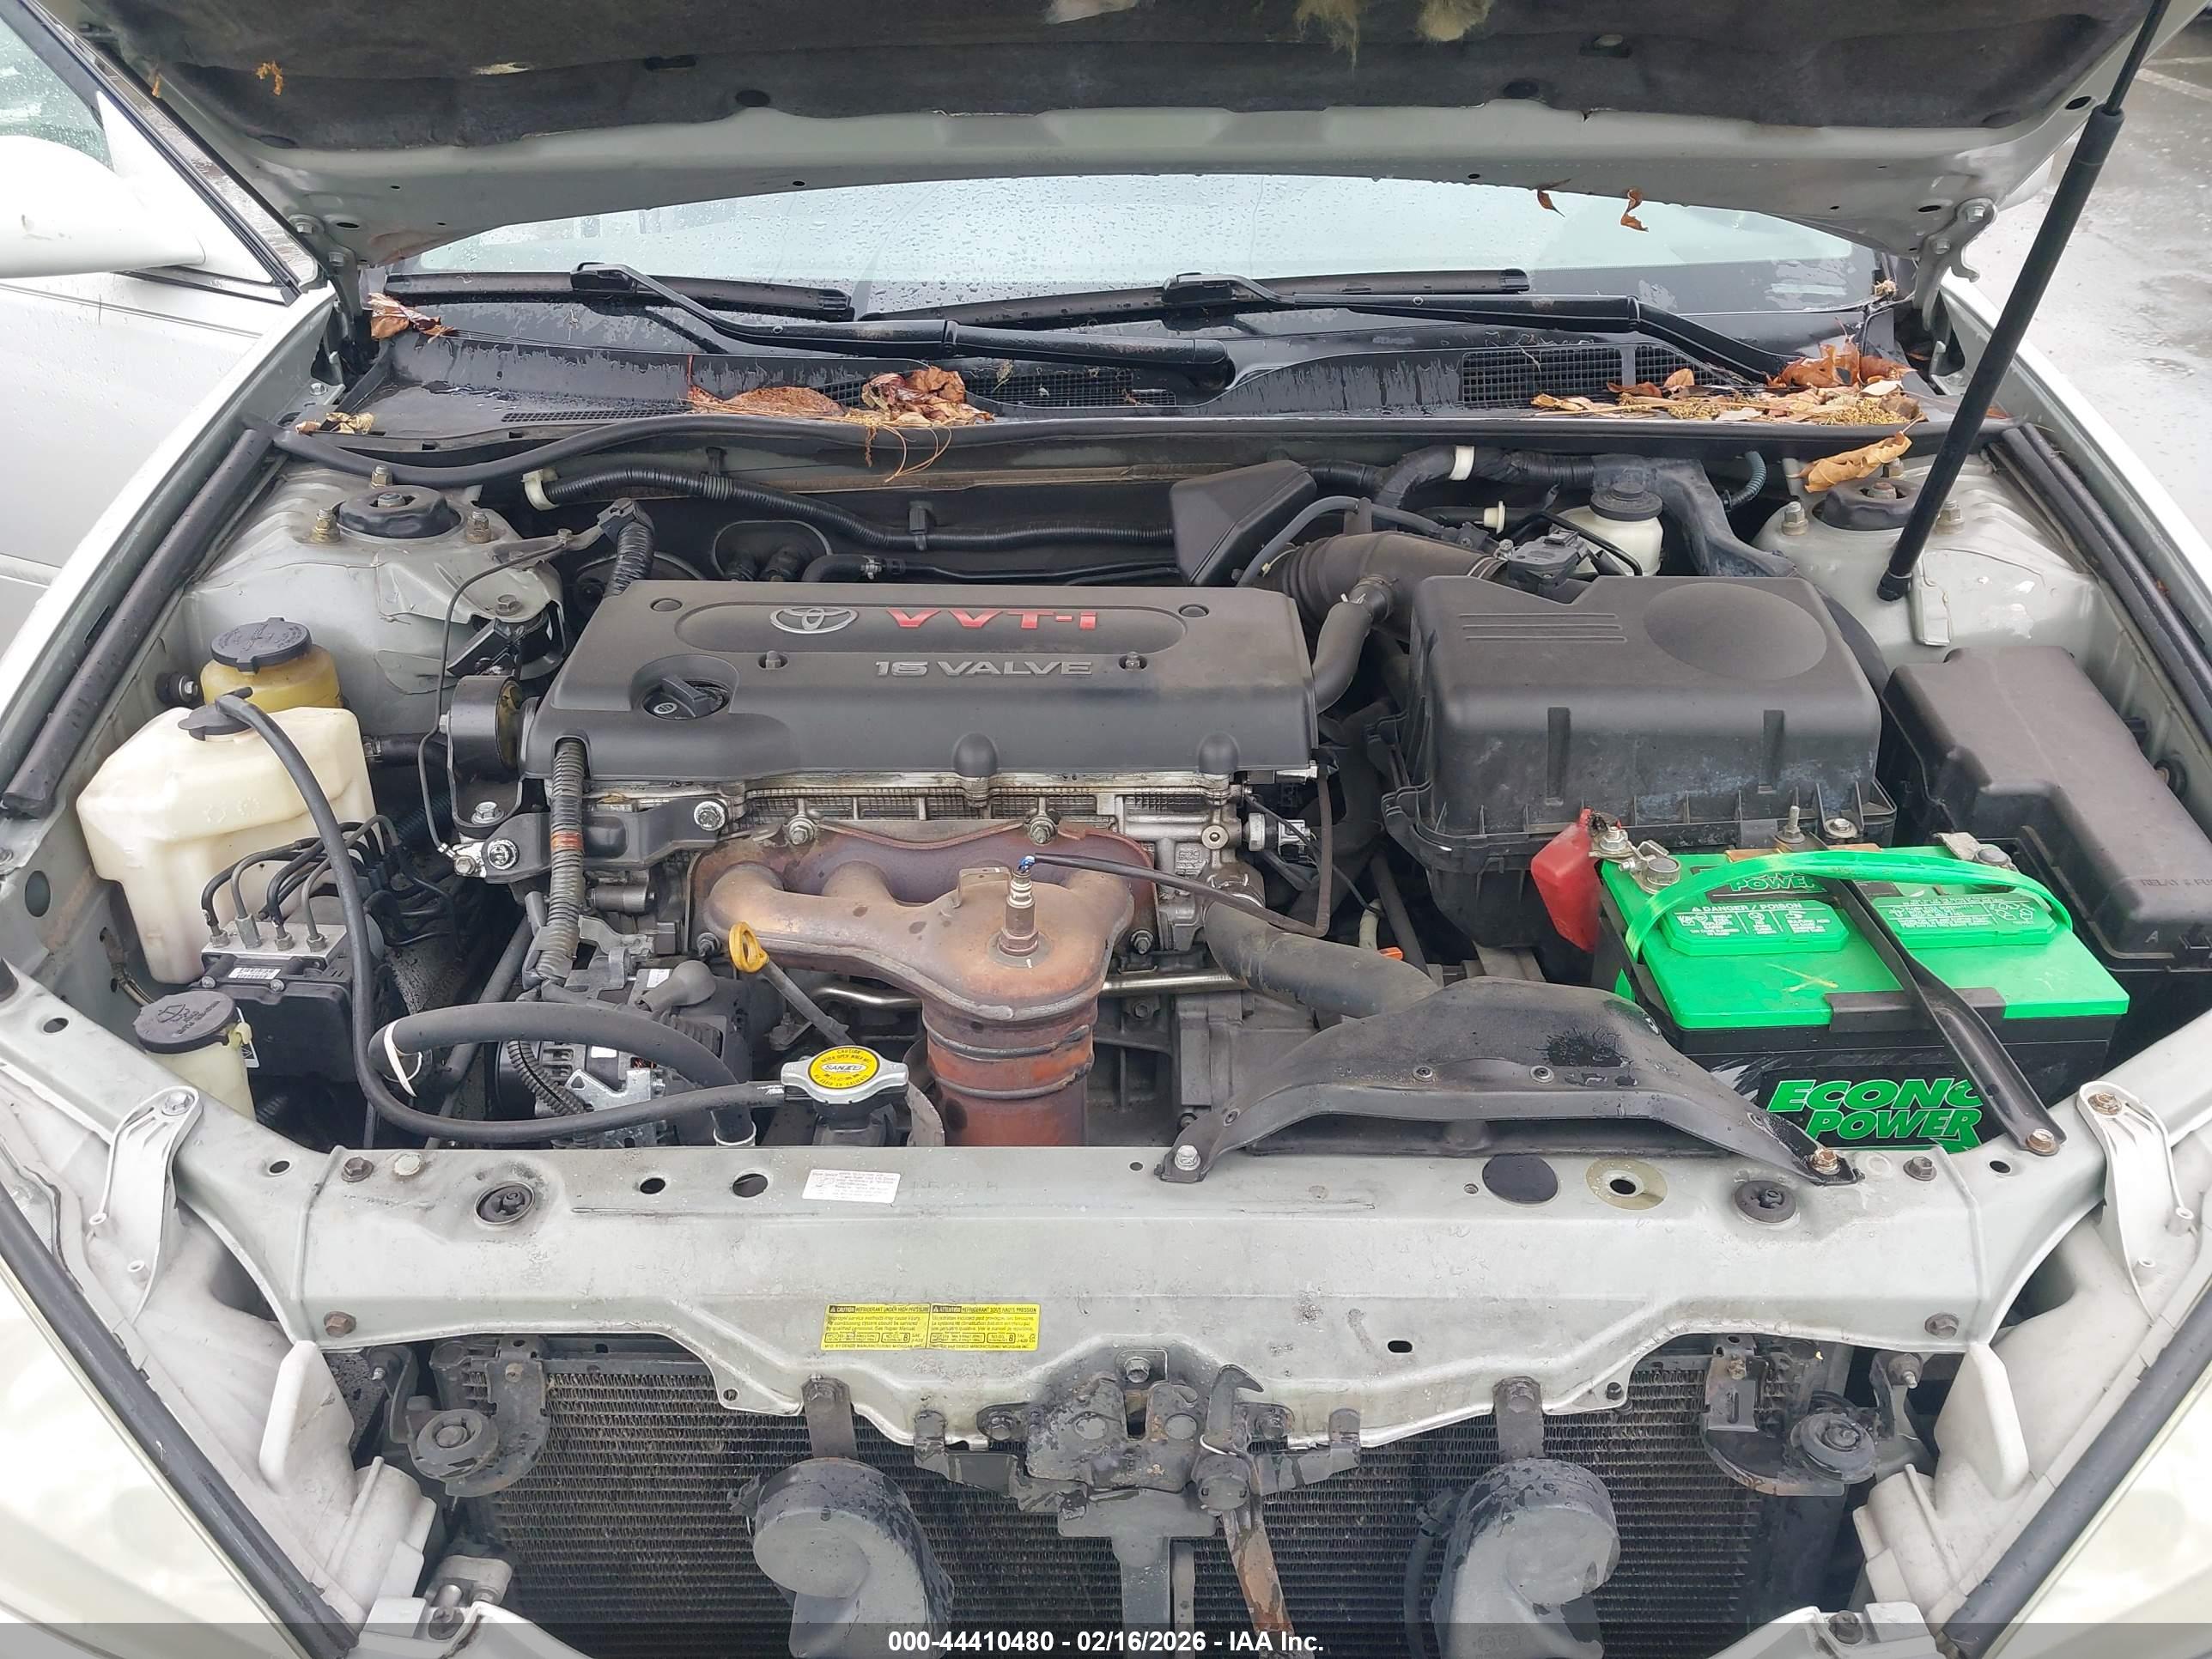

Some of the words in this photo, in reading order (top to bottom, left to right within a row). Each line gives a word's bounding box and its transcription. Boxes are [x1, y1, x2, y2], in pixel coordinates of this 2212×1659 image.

[886, 607, 1097, 629] VVT-i
[875, 661, 927, 677] 16
[938, 661, 1092, 677] VALVE
[1805, 1108, 1982, 1140] POWER
